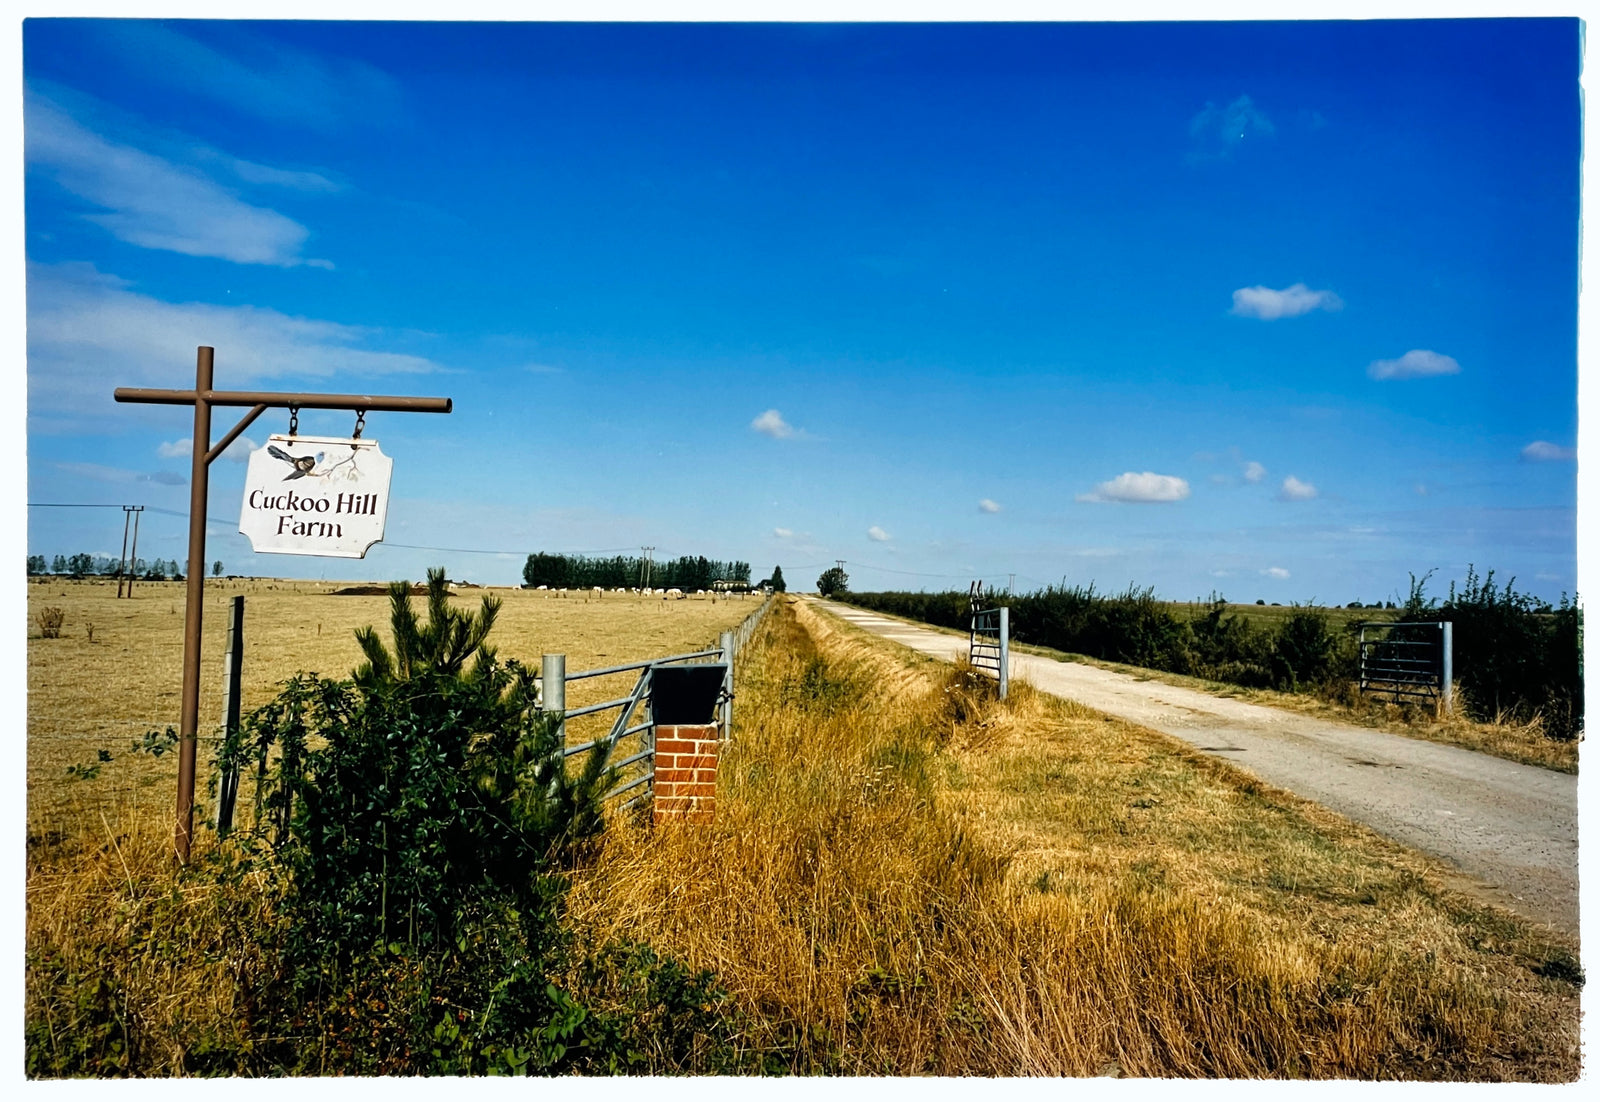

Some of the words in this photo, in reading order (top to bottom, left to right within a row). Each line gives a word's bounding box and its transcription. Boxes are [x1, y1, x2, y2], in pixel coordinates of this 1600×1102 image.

[249, 489, 330, 513] Cuckoo
[335, 492, 377, 515] Hill
[276, 515, 343, 538] Farm
